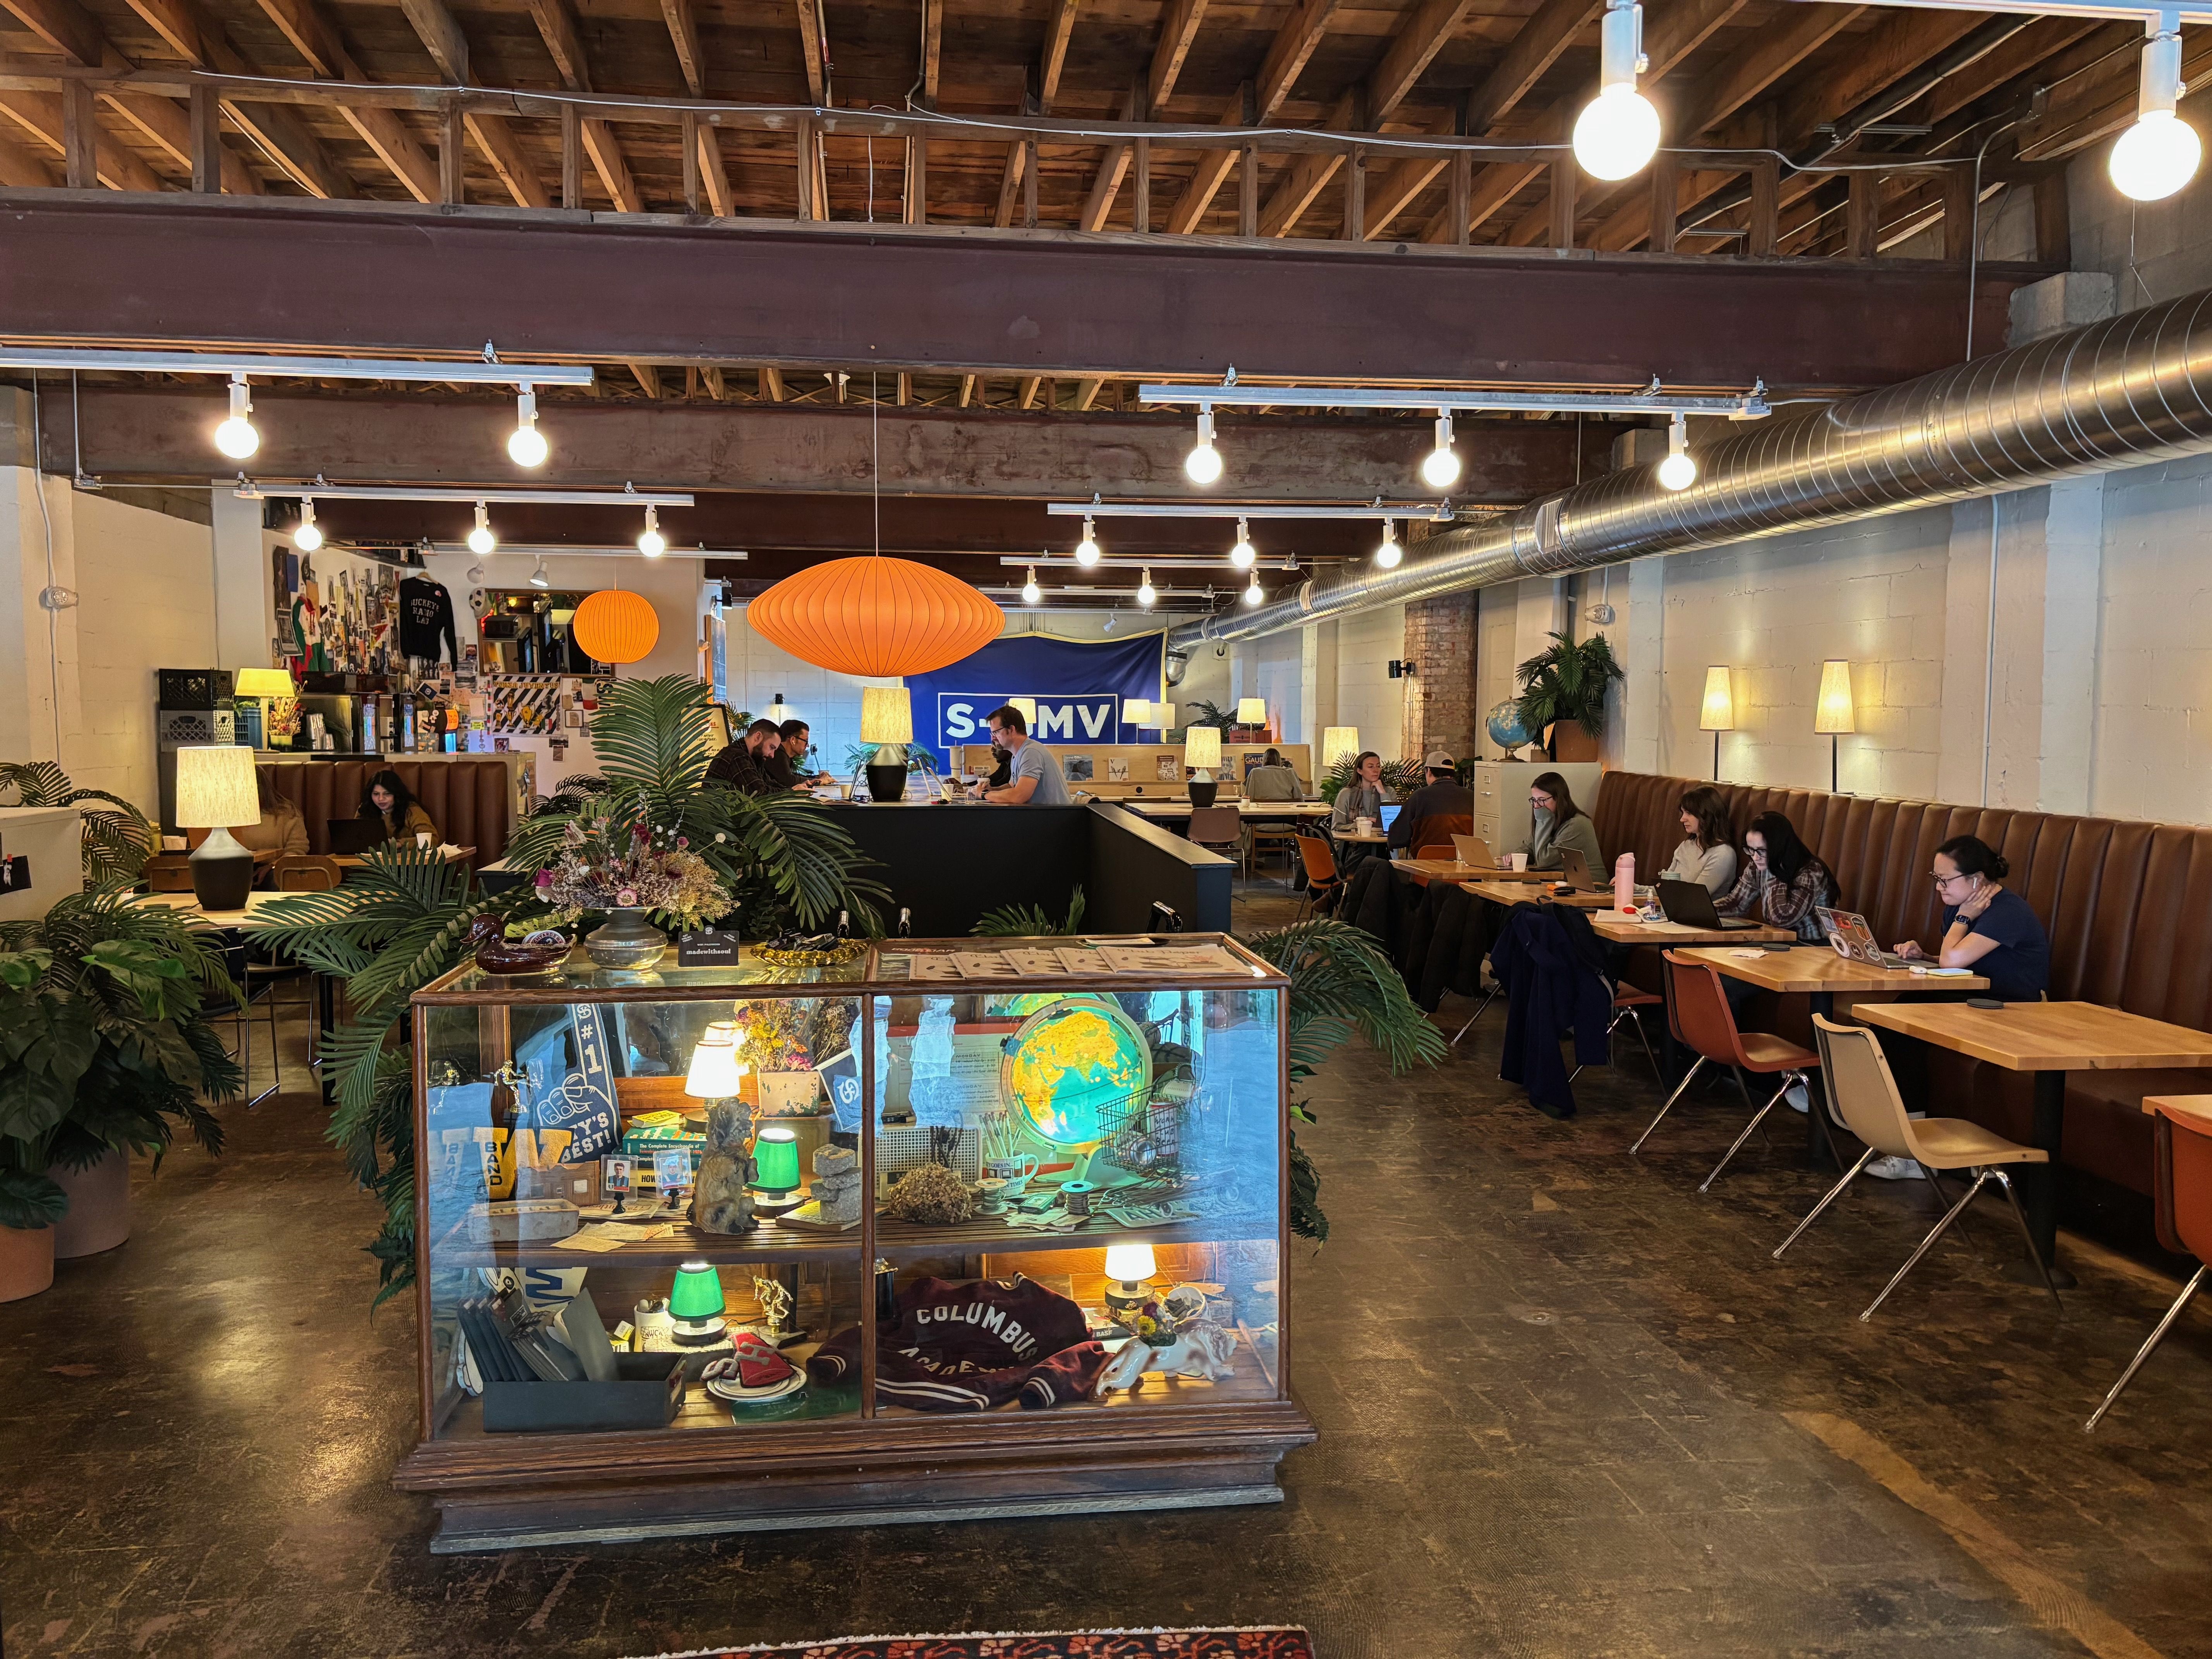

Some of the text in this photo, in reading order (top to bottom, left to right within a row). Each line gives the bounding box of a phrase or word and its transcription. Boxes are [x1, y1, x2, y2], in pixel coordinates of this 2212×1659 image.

[946, 703, 1111, 738] S-MV
[485, 1142, 503, 1186] BAND
[641, 1175, 656, 1183] HOW
[917, 1302, 1038, 1361] COLUMBUS
